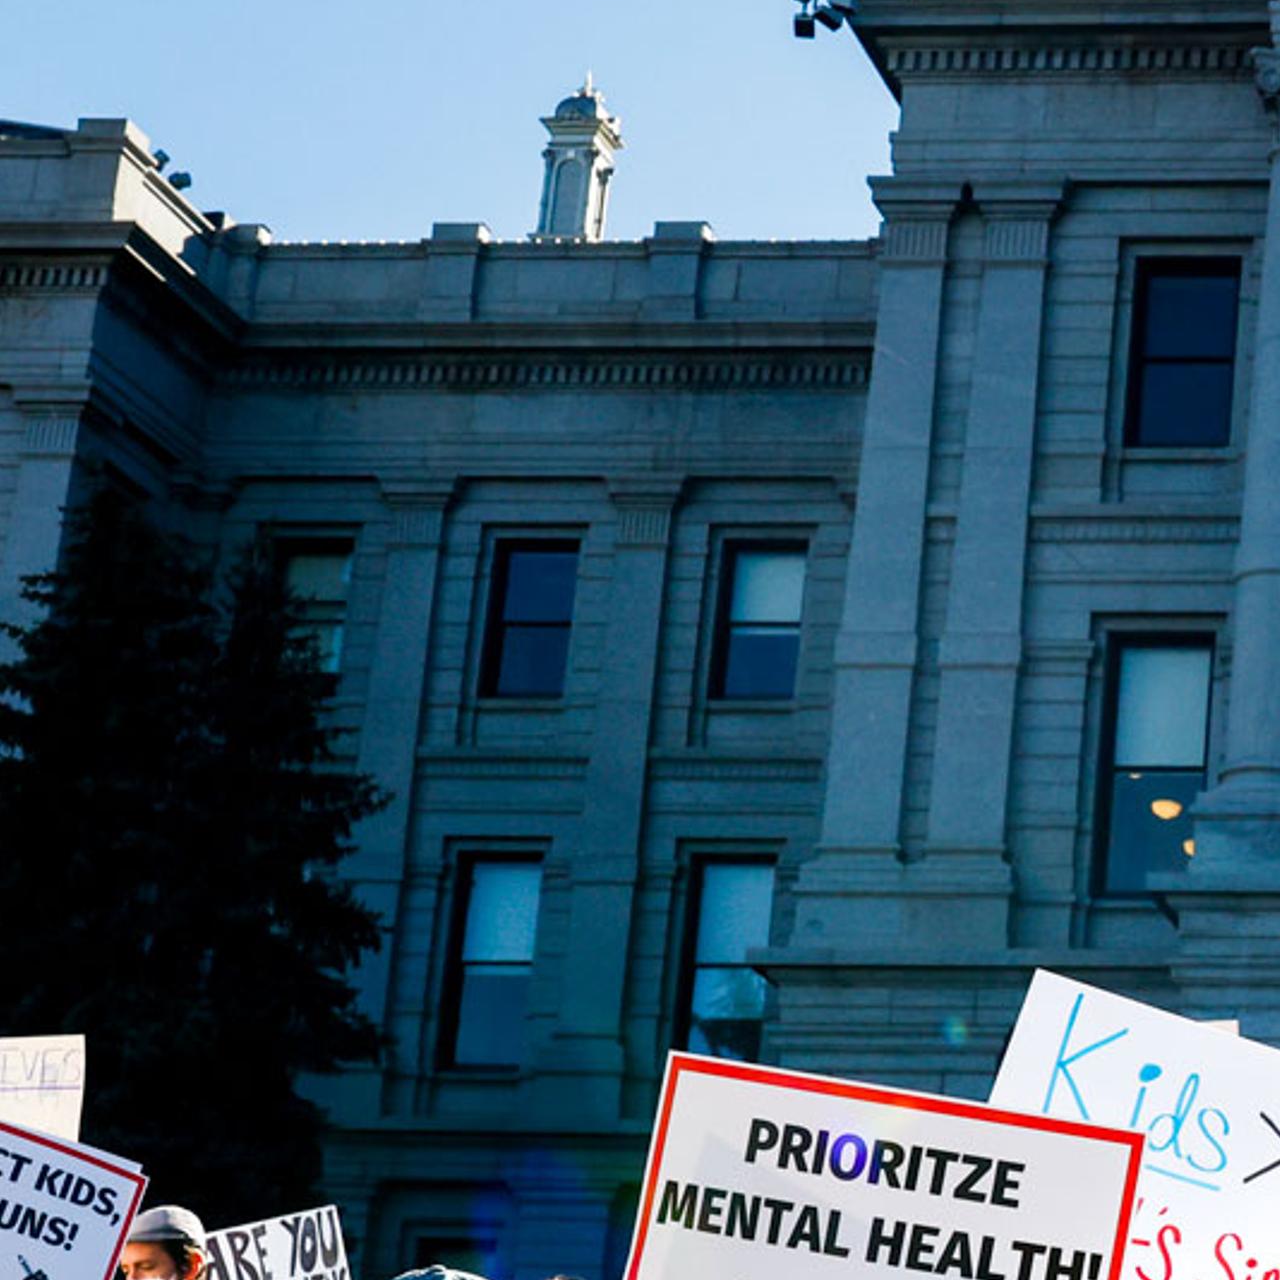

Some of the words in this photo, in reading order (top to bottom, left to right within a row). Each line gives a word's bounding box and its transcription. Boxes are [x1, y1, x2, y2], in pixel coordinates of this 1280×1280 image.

[1042, 992, 1231, 1173] Kids
[34, 1163, 120, 1227] KIDS,
[744, 1118, 1025, 1208] PRIORITZE
[280, 1209, 339, 1277] YOU
[656, 1180, 850, 1258] MENTAL
